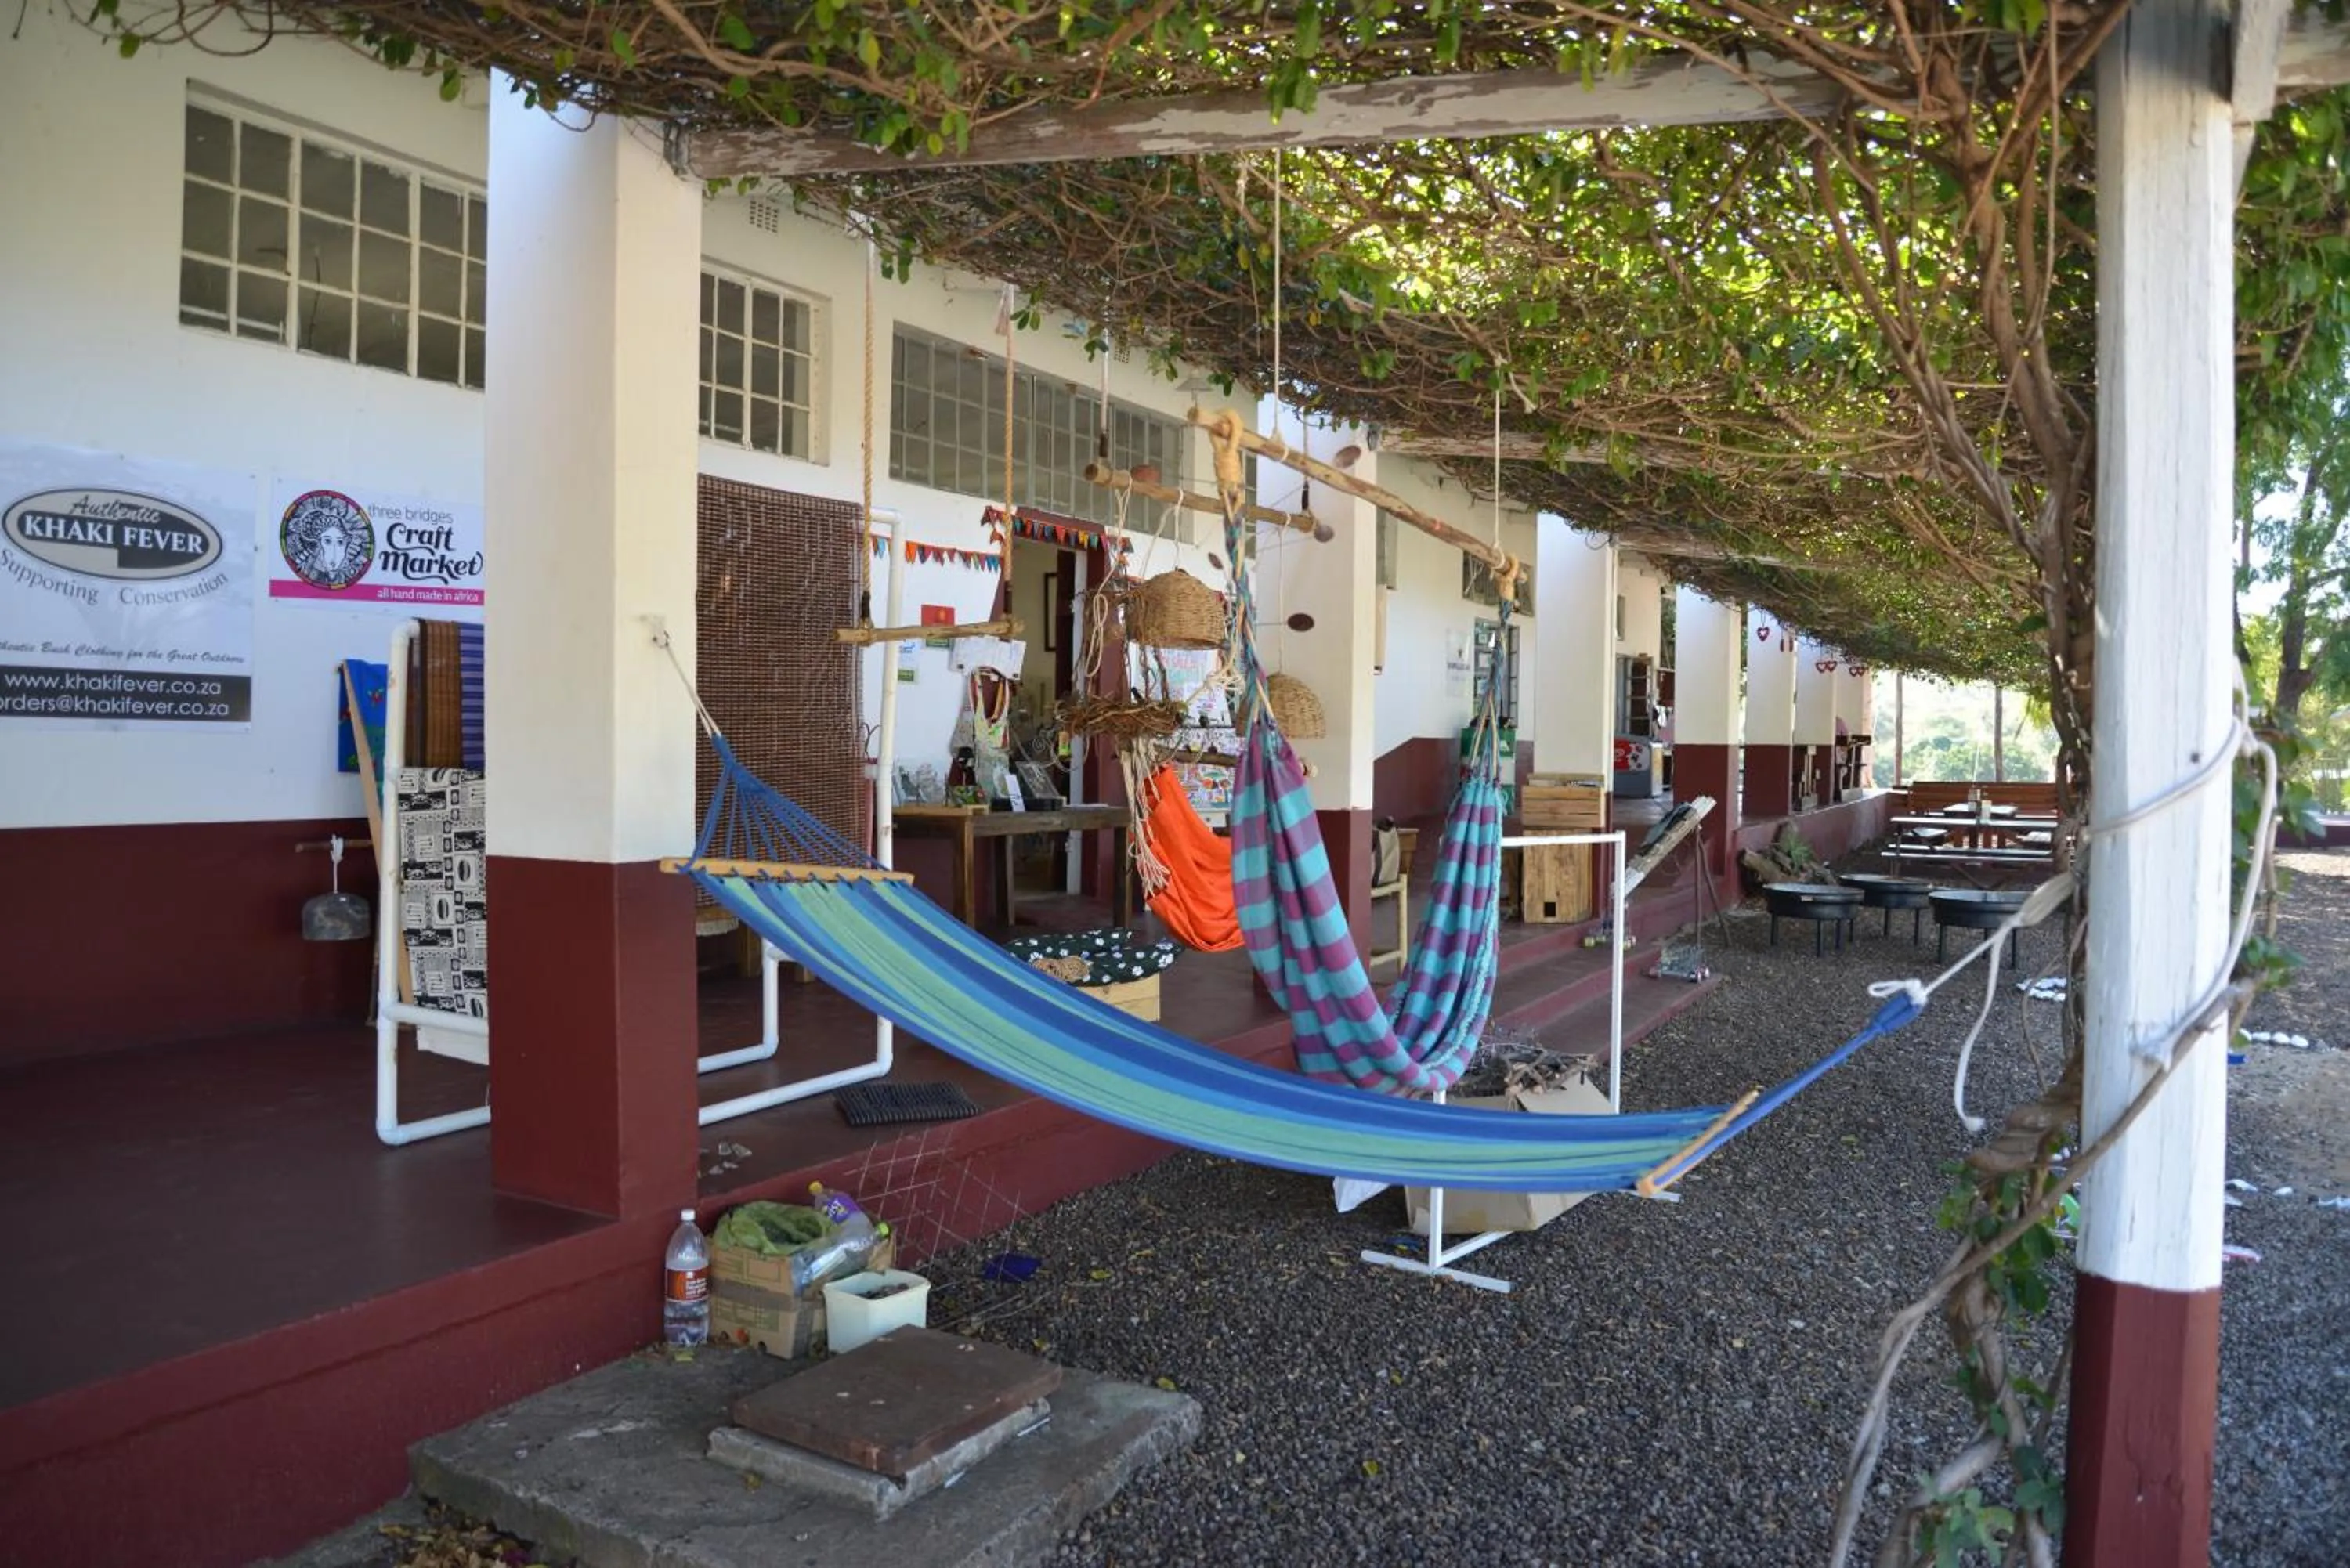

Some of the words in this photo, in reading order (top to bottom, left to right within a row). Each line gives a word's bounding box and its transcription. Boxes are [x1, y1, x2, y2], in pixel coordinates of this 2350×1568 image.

[69, 494, 161, 523] Authentic
[368, 505, 401, 519] three
[405, 507, 454, 525] bridges
[24, 514, 114, 544] KHAKI
[122, 526, 204, 554] FEVER
[386, 522, 457, 556] Craft
[0, 548, 99, 605] Supporting
[119, 572, 229, 606] Conservation
[379, 551, 483, 585] Market
[377, 588, 389, 598] all
[391, 589, 414, 600] hand
[416, 590, 443, 601] made
[443, 591, 453, 601] in
[454, 591, 479, 602] africa
[146, 649, 163, 659] the
[4, 672, 222, 695] www.khakifever.co.za
